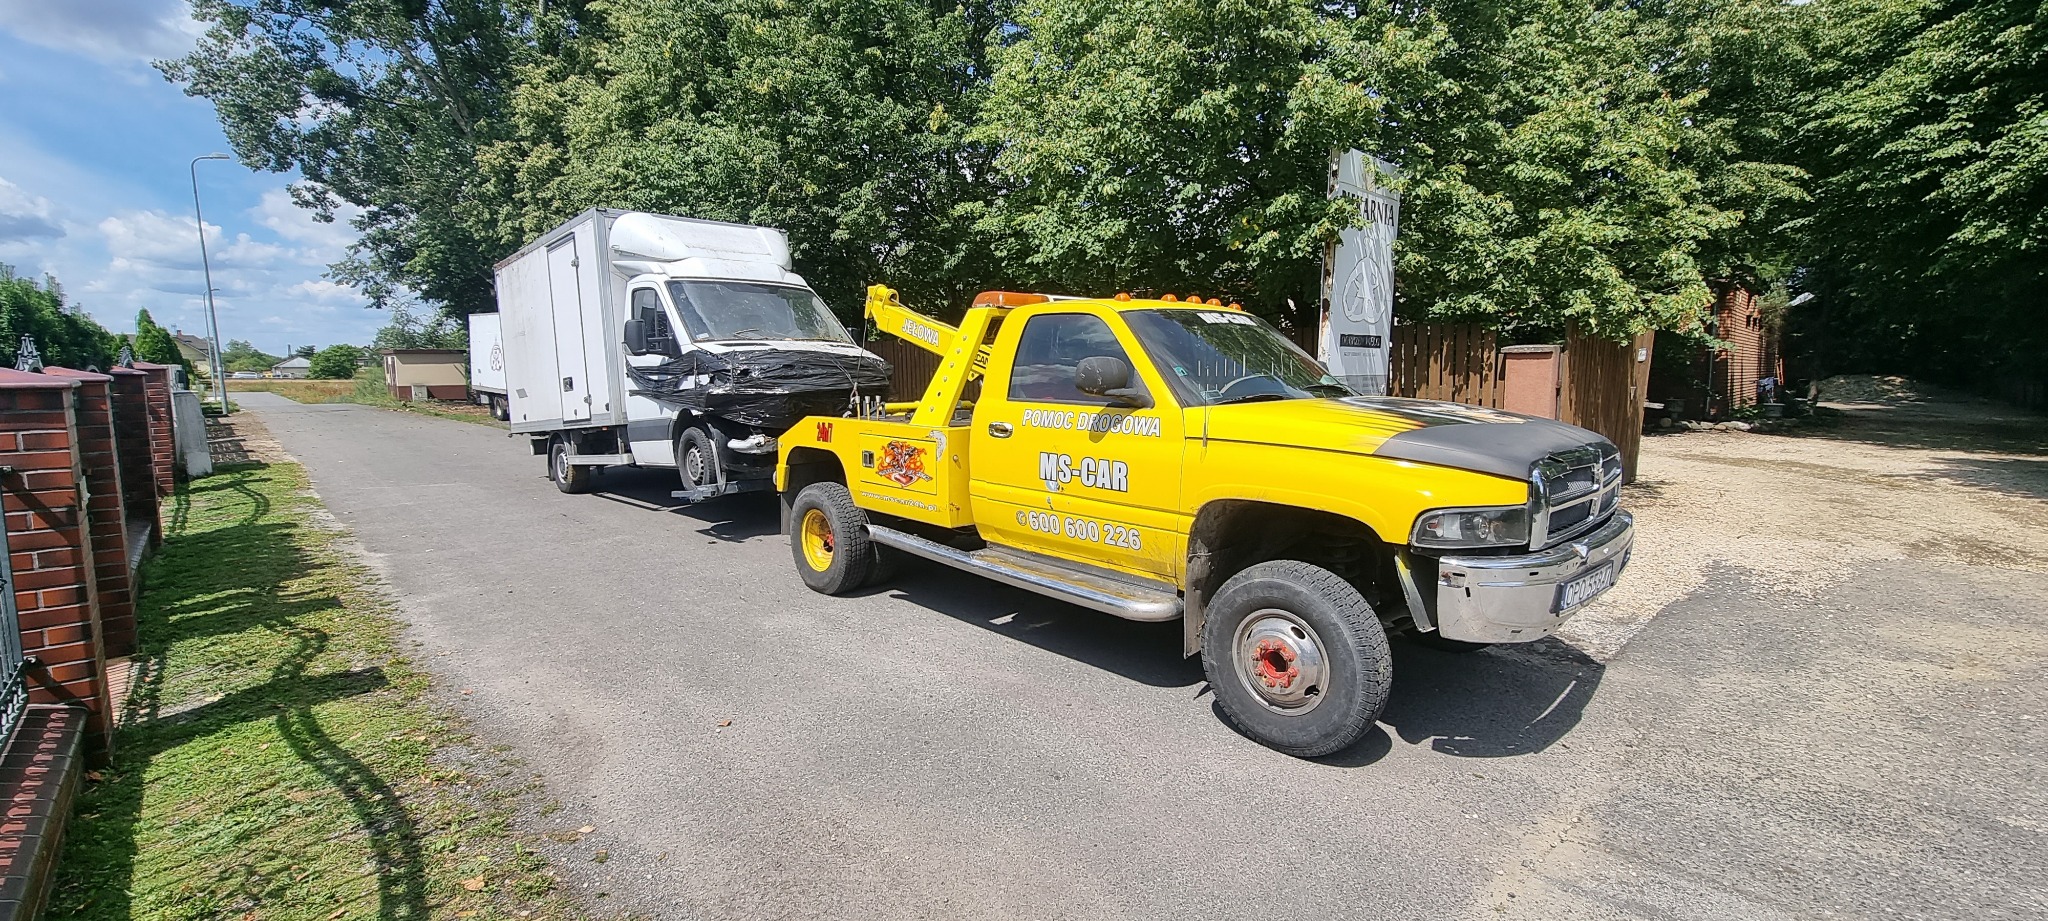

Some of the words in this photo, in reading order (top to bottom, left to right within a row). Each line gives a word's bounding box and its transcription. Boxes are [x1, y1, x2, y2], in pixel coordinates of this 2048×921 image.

[902, 318, 939, 347] JEŁOWA
[1022, 409, 1074, 430] POMOC
[1076, 412, 1160, 437] DROGOWA
[1039, 451, 1129, 493] MS-CAR
[1028, 510, 1060, 535] 600
[1064, 516, 1099, 542] 600
[1103, 523, 1142, 550] 226
